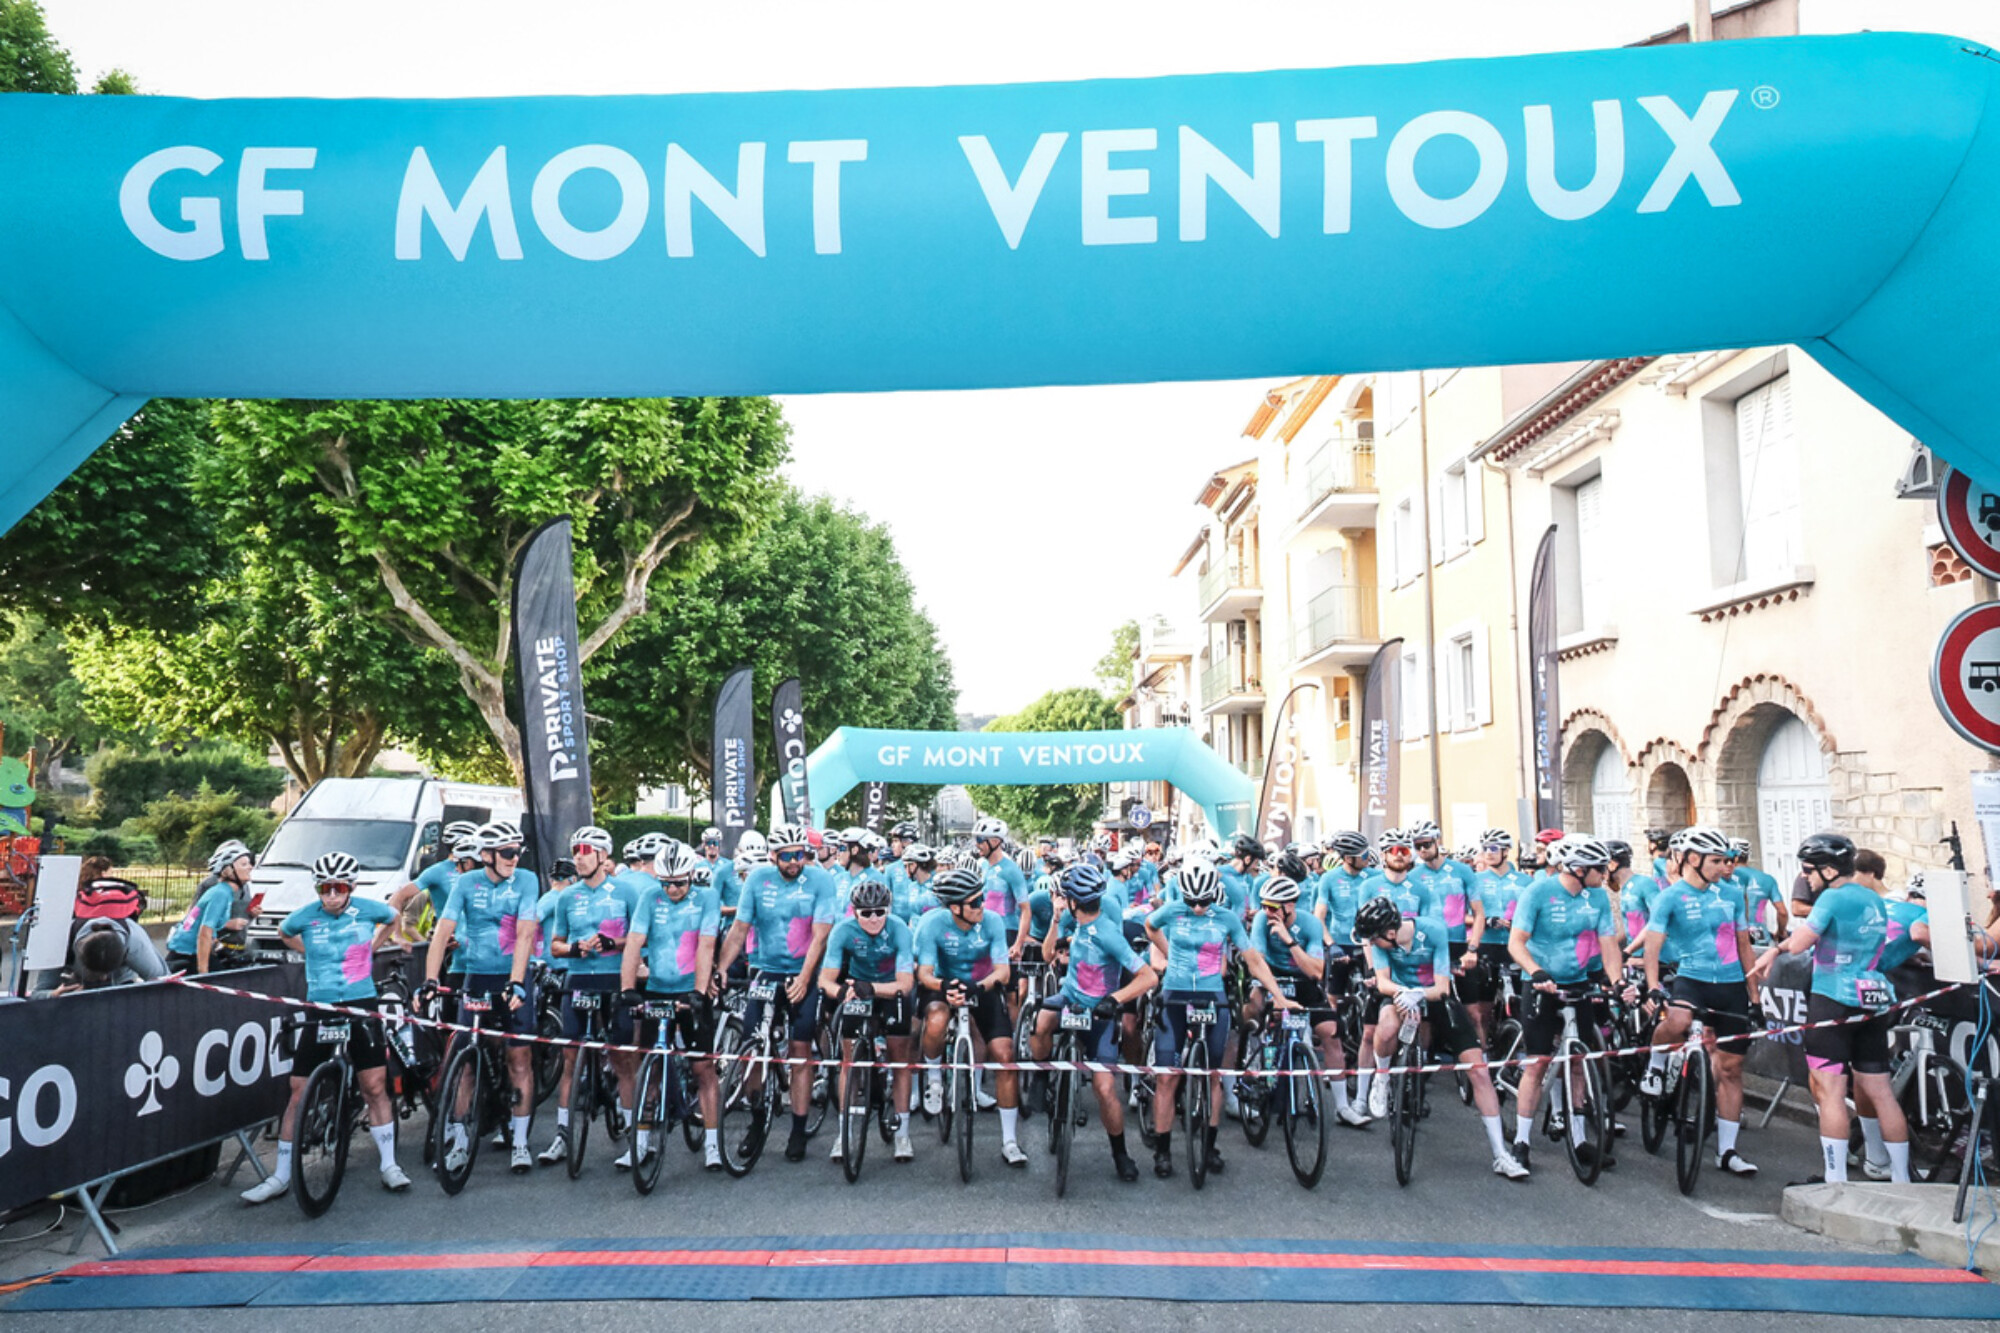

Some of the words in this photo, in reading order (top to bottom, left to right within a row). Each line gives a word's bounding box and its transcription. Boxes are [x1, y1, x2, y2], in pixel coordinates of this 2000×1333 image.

[119, 145, 317, 261] GF
[395, 139, 869, 262] MONT
[555, 636, 569, 683] SHOP
[535, 636, 564, 751] PRIVATE
[559, 690, 575, 747] SPORT
[724, 738, 738, 811] PRIVATE
[737, 738, 746, 768] SHOP
[878, 746, 911, 766] GF
[923, 746, 1003, 767] MONT
[1018, 742, 1144, 766] VENTOUX
[1368, 719, 1382, 795] PRIVATE
[738, 772, 746, 807] SPORT
[1758, 986, 1808, 1023] ATE
[1766, 1020, 1806, 1046] SHO
[0, 1062, 77, 1157] O
